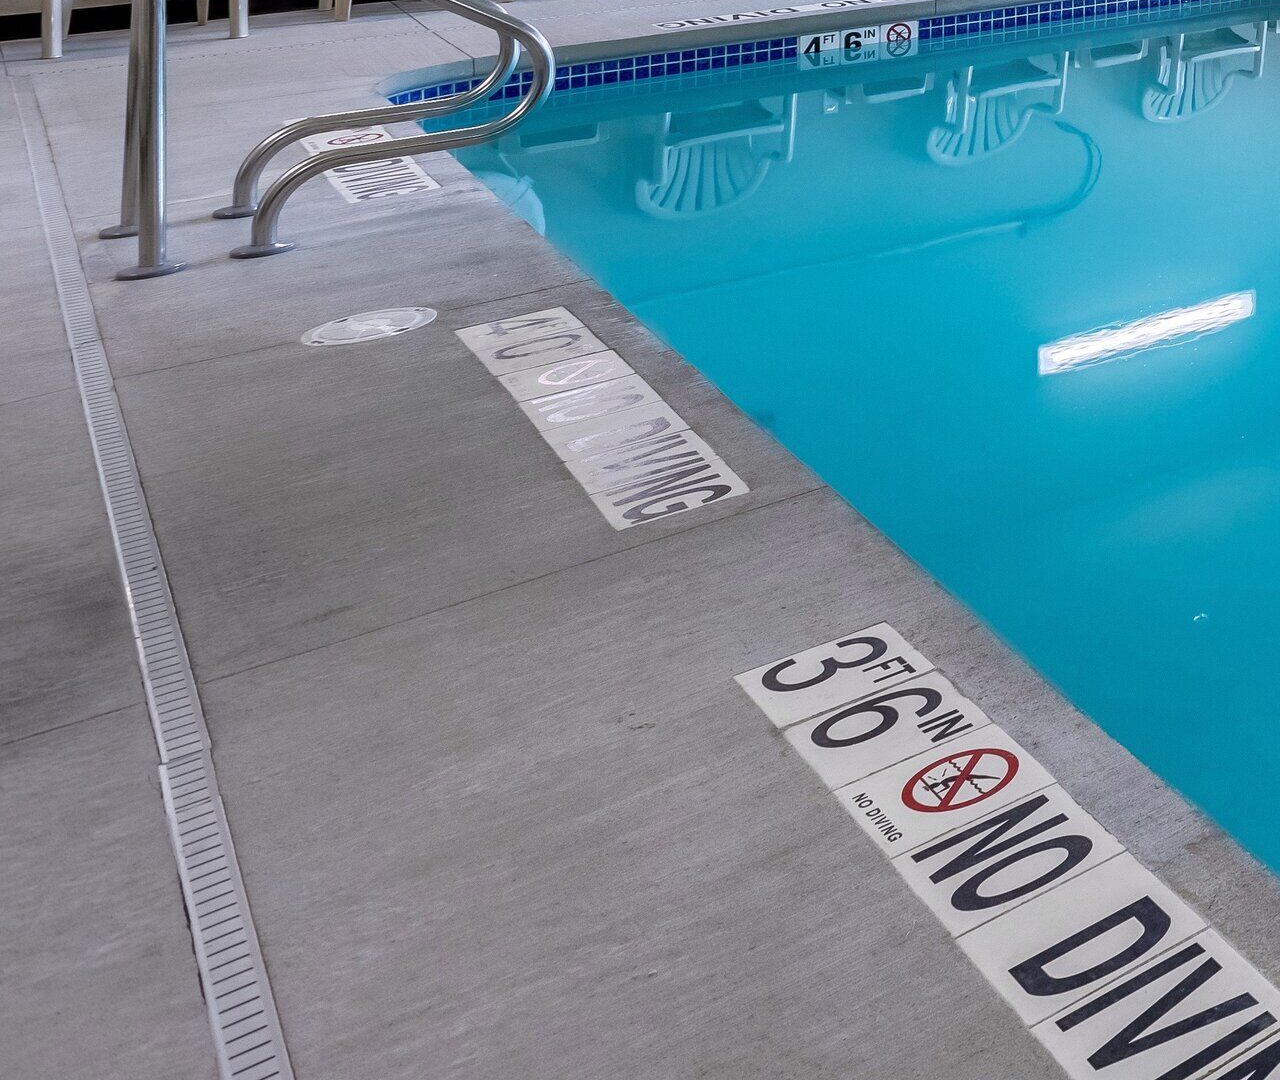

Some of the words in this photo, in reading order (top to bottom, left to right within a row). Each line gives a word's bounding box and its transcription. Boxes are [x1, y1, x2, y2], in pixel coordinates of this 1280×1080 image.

[803, 36, 823, 54] 4
[823, 34, 836, 44] FT
[844, 31, 862, 50] 6
[864, 29, 876, 39] IN
[565, 416, 732, 526] DIVING
[761, 636, 888, 692] 3
[862, 655, 917, 684] FT
[810, 687, 943, 749] 6
[916, 708, 974, 743] IN
[851, 792, 874, 809] NO
[865, 807, 903, 843] DIVING
[910, 794, 1094, 912] NO
